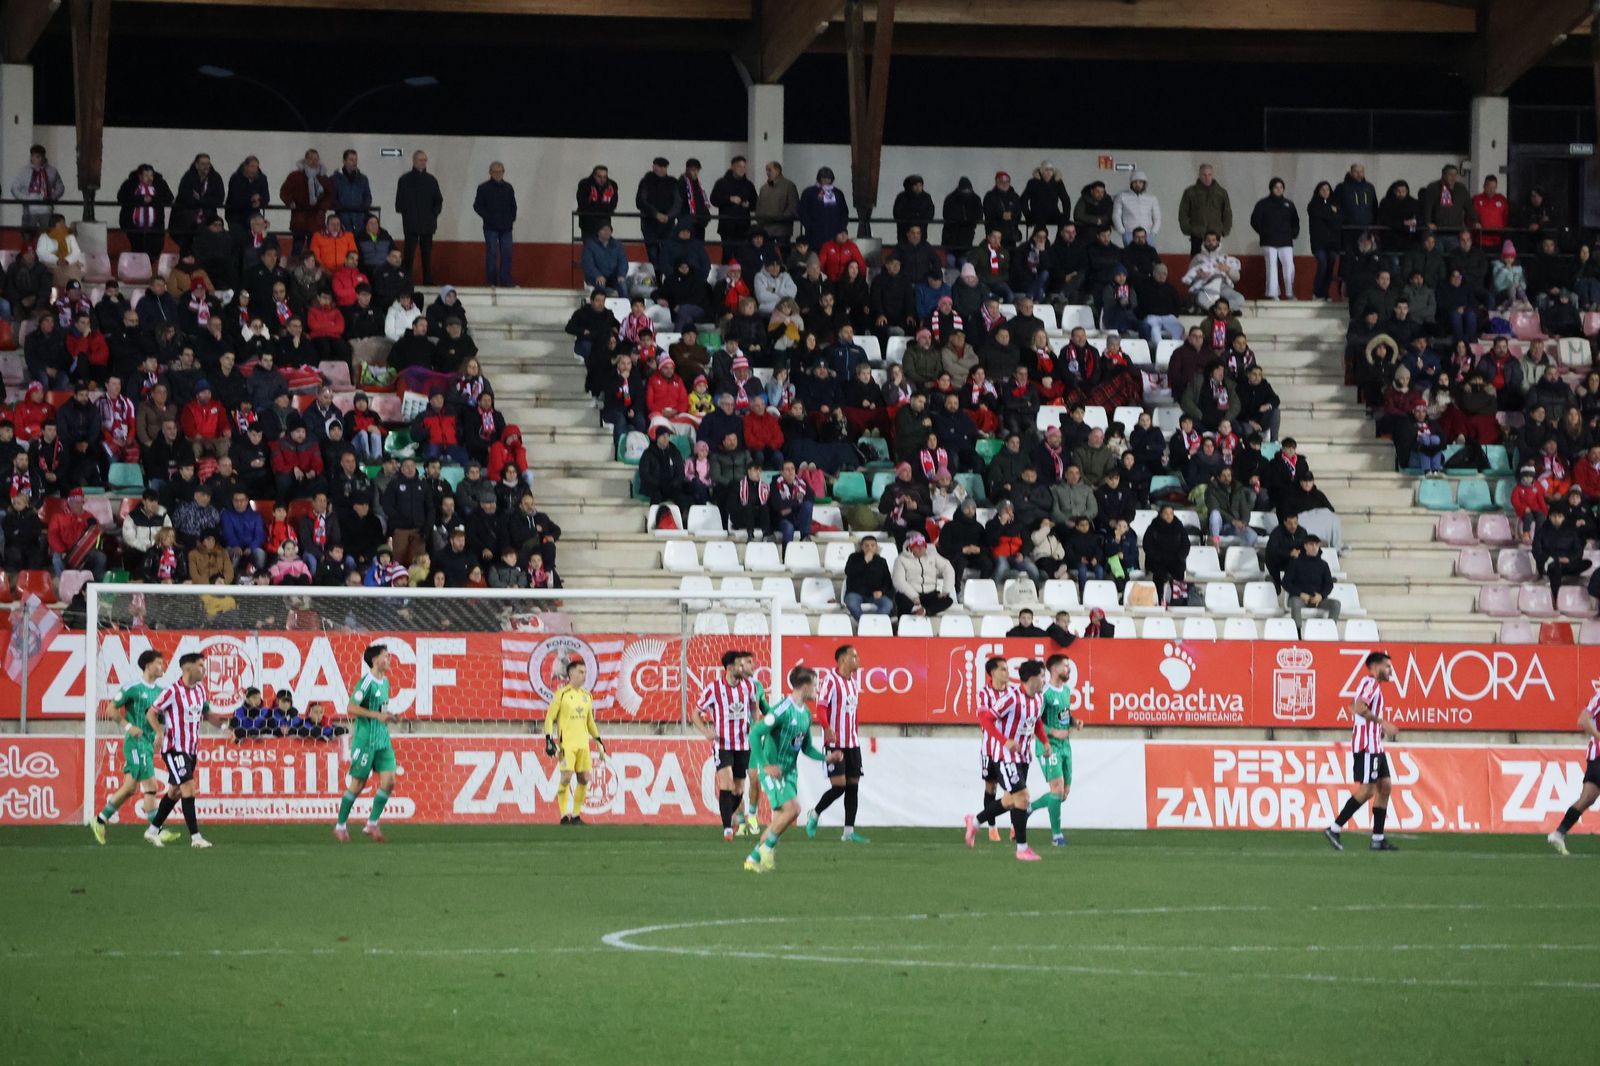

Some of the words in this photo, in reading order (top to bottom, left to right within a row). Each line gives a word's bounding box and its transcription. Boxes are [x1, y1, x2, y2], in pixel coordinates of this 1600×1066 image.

[546, 639, 581, 650] FONDO
[1109, 687, 1244, 721] podoactiva
[1128, 710, 1175, 721] PODOLOGÍA
[1177, 711, 1183, 721] Y
[1185, 711, 1243, 722] BIOMECÁNICA
[1337, 706, 1473, 724] ATAMIENTO
[174, 755, 185, 769] 10
[197, 745, 277, 765] odegas
